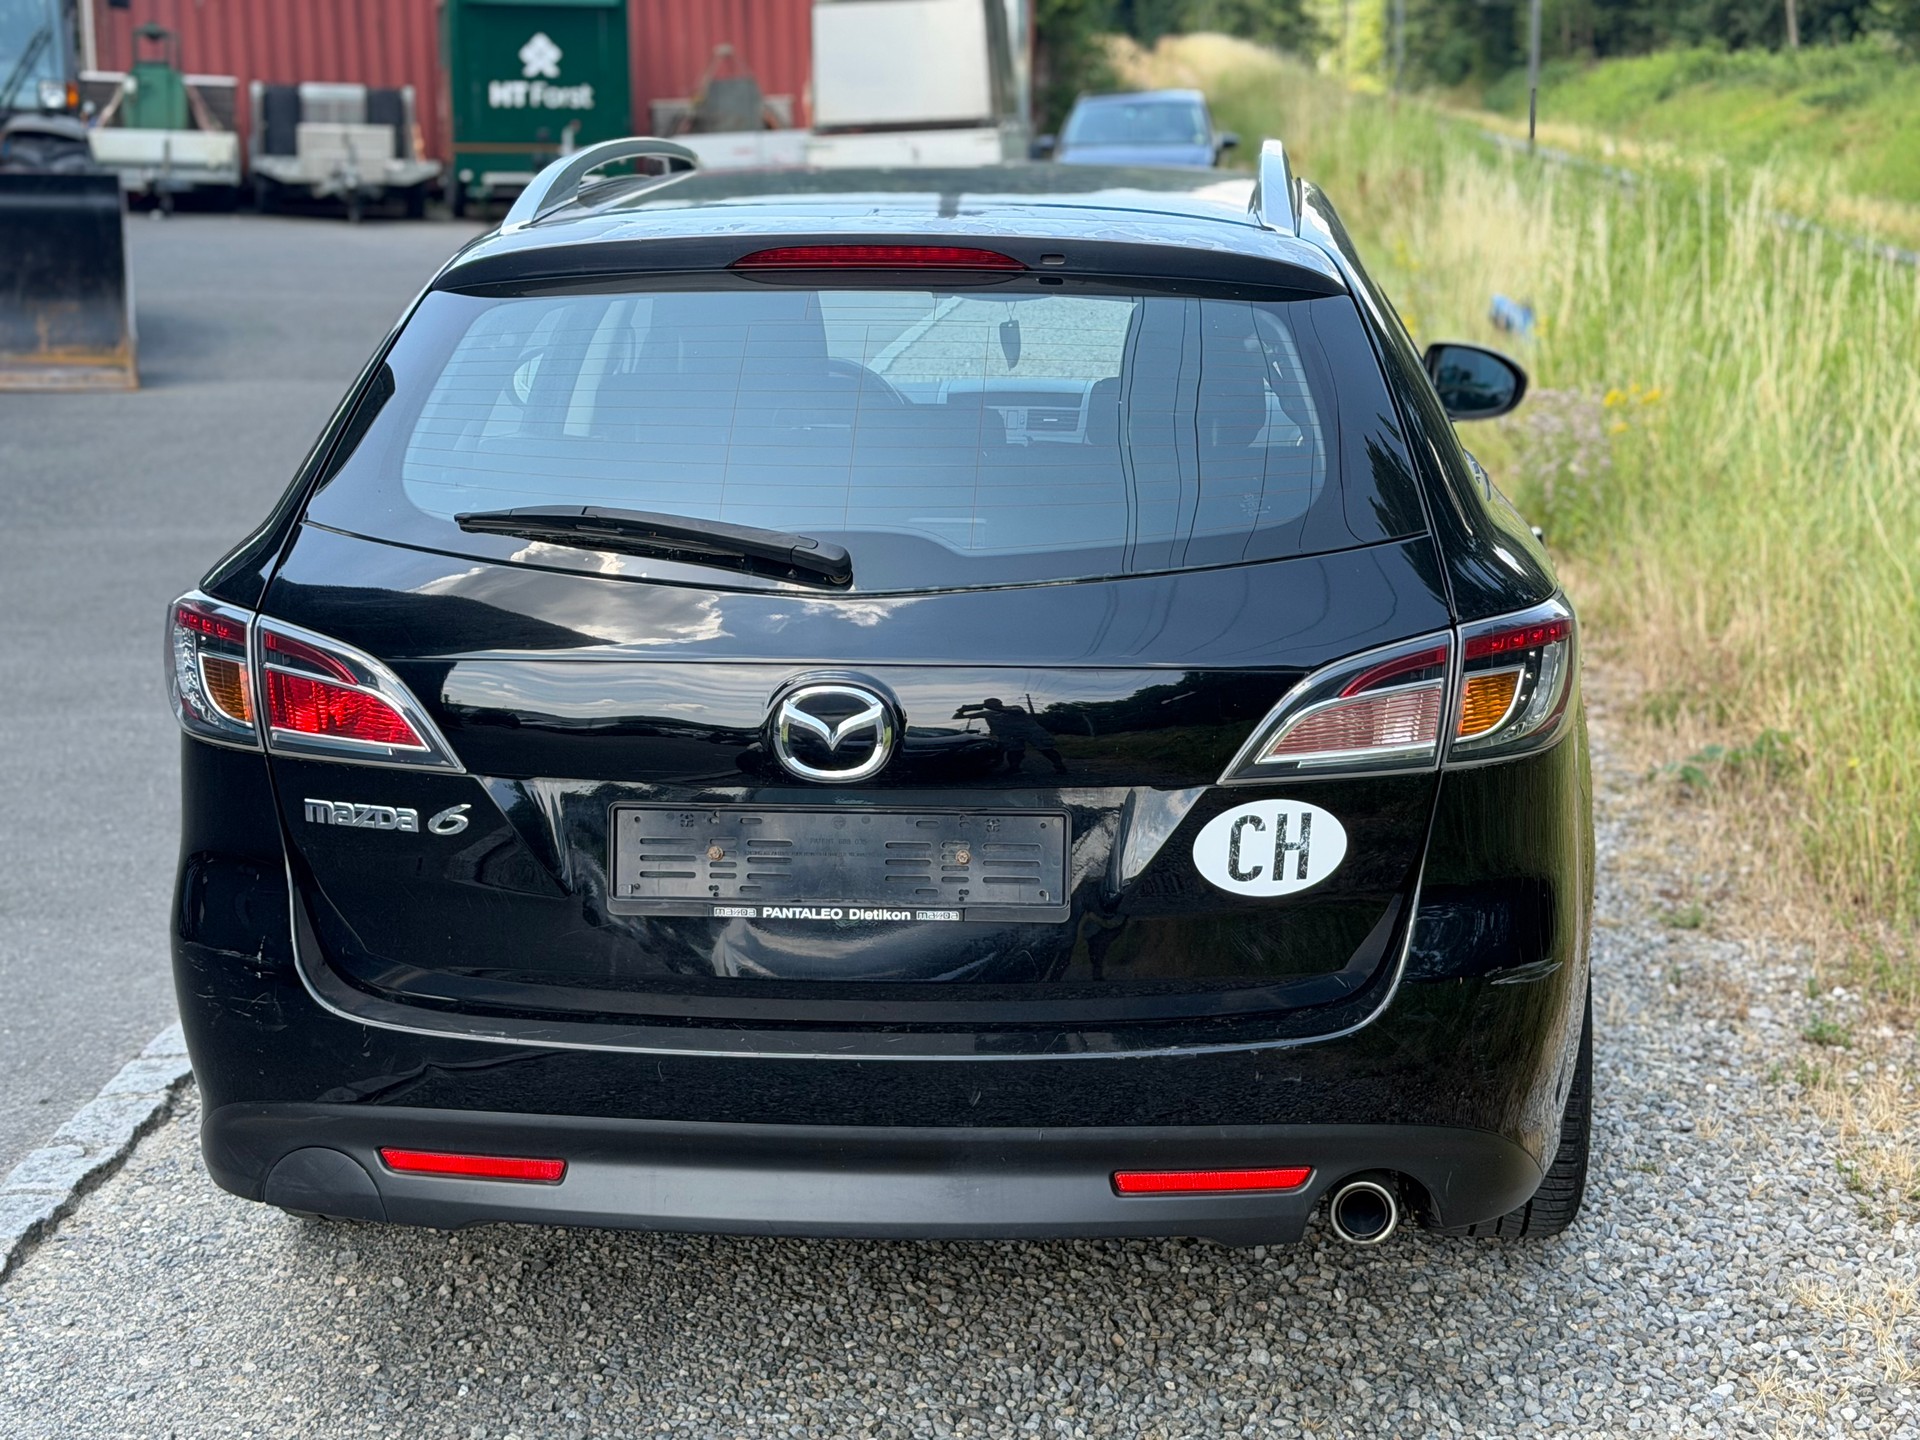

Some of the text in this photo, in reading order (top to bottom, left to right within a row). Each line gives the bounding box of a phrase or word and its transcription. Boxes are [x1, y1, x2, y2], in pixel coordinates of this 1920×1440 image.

[488, 80, 595, 110] HT Forst
[428, 804, 472, 835] 6
[1227, 812, 1312, 882] CH
[762, 907, 843, 920] PANTALEO
[849, 909, 911, 920] Dietikon
